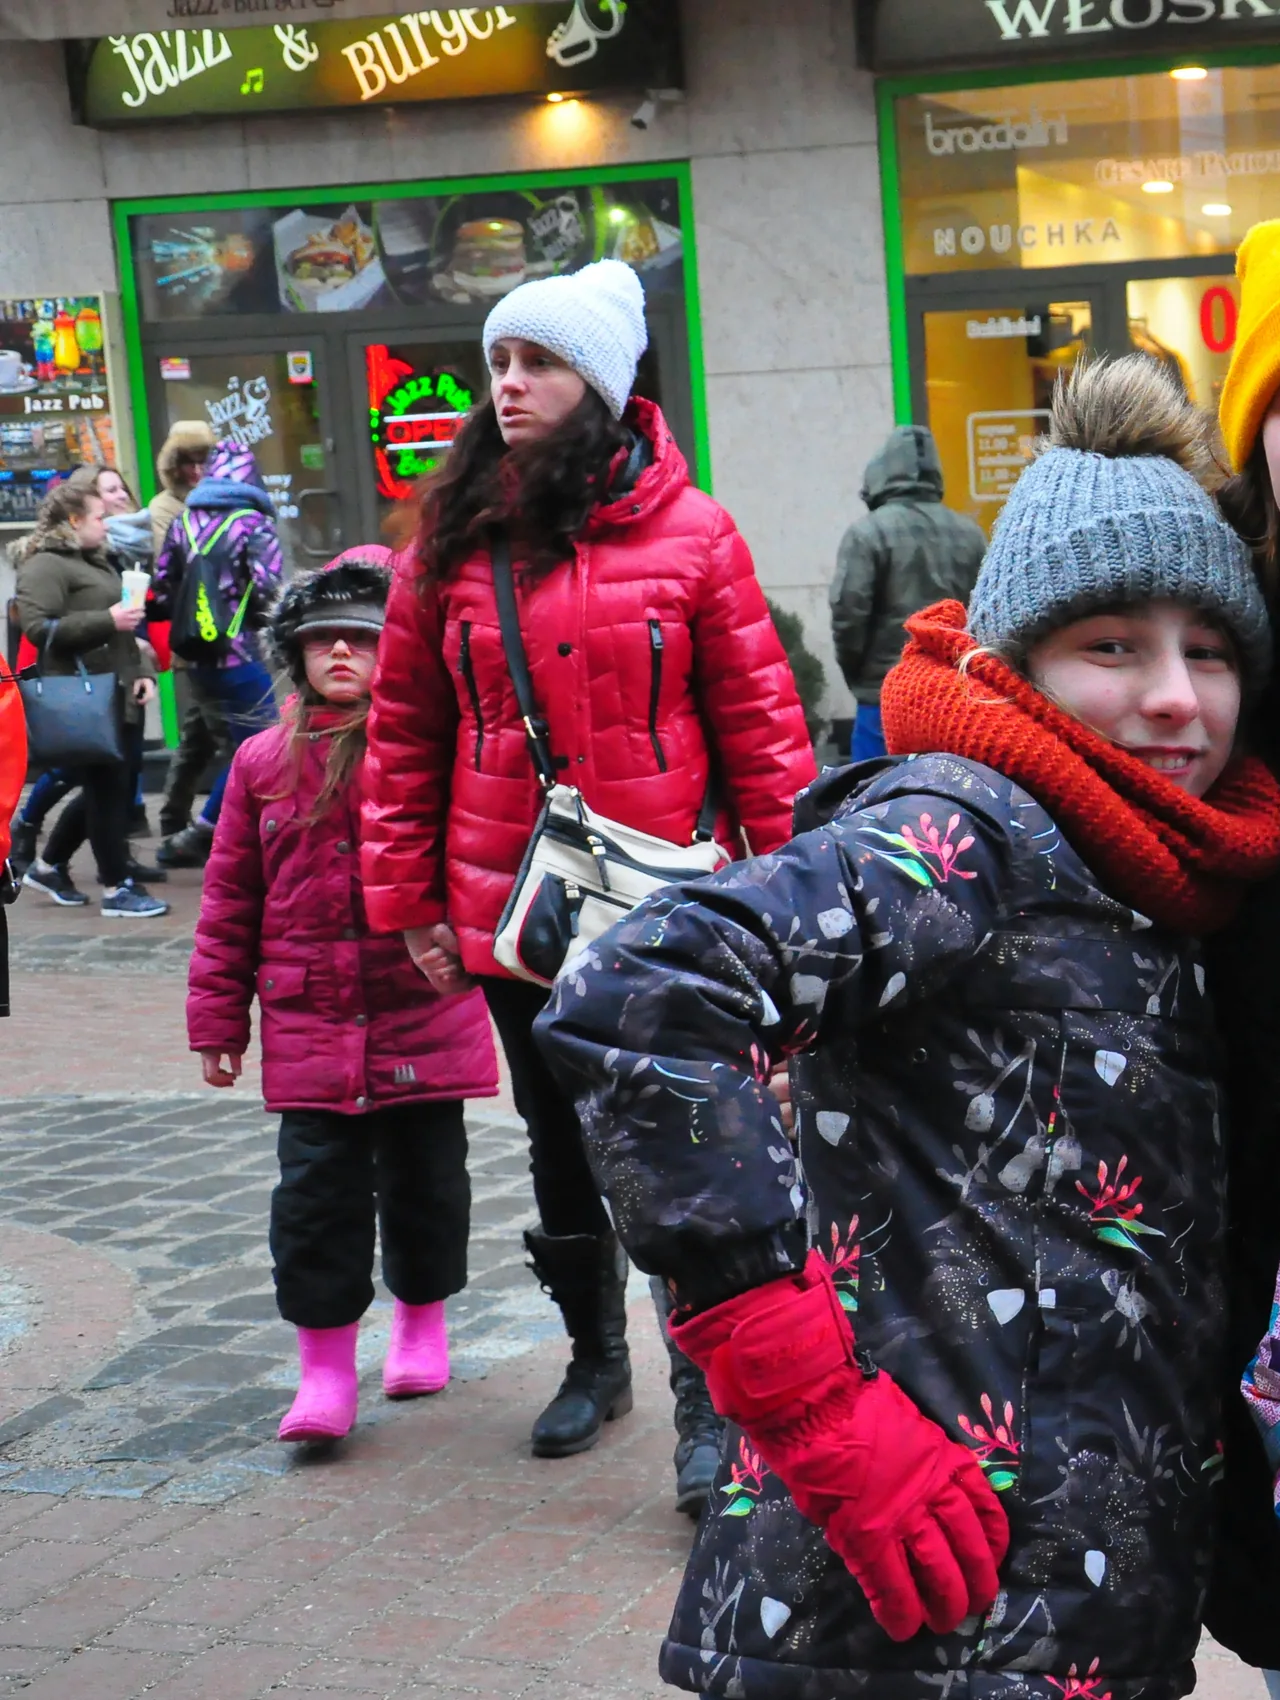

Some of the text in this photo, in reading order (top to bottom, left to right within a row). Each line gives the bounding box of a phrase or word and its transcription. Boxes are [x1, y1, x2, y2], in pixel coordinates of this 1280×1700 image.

[273, 23, 319, 71] &
[933, 218, 1122, 256] NOUCHKA
[24, 394, 105, 415] Jazz Pub
